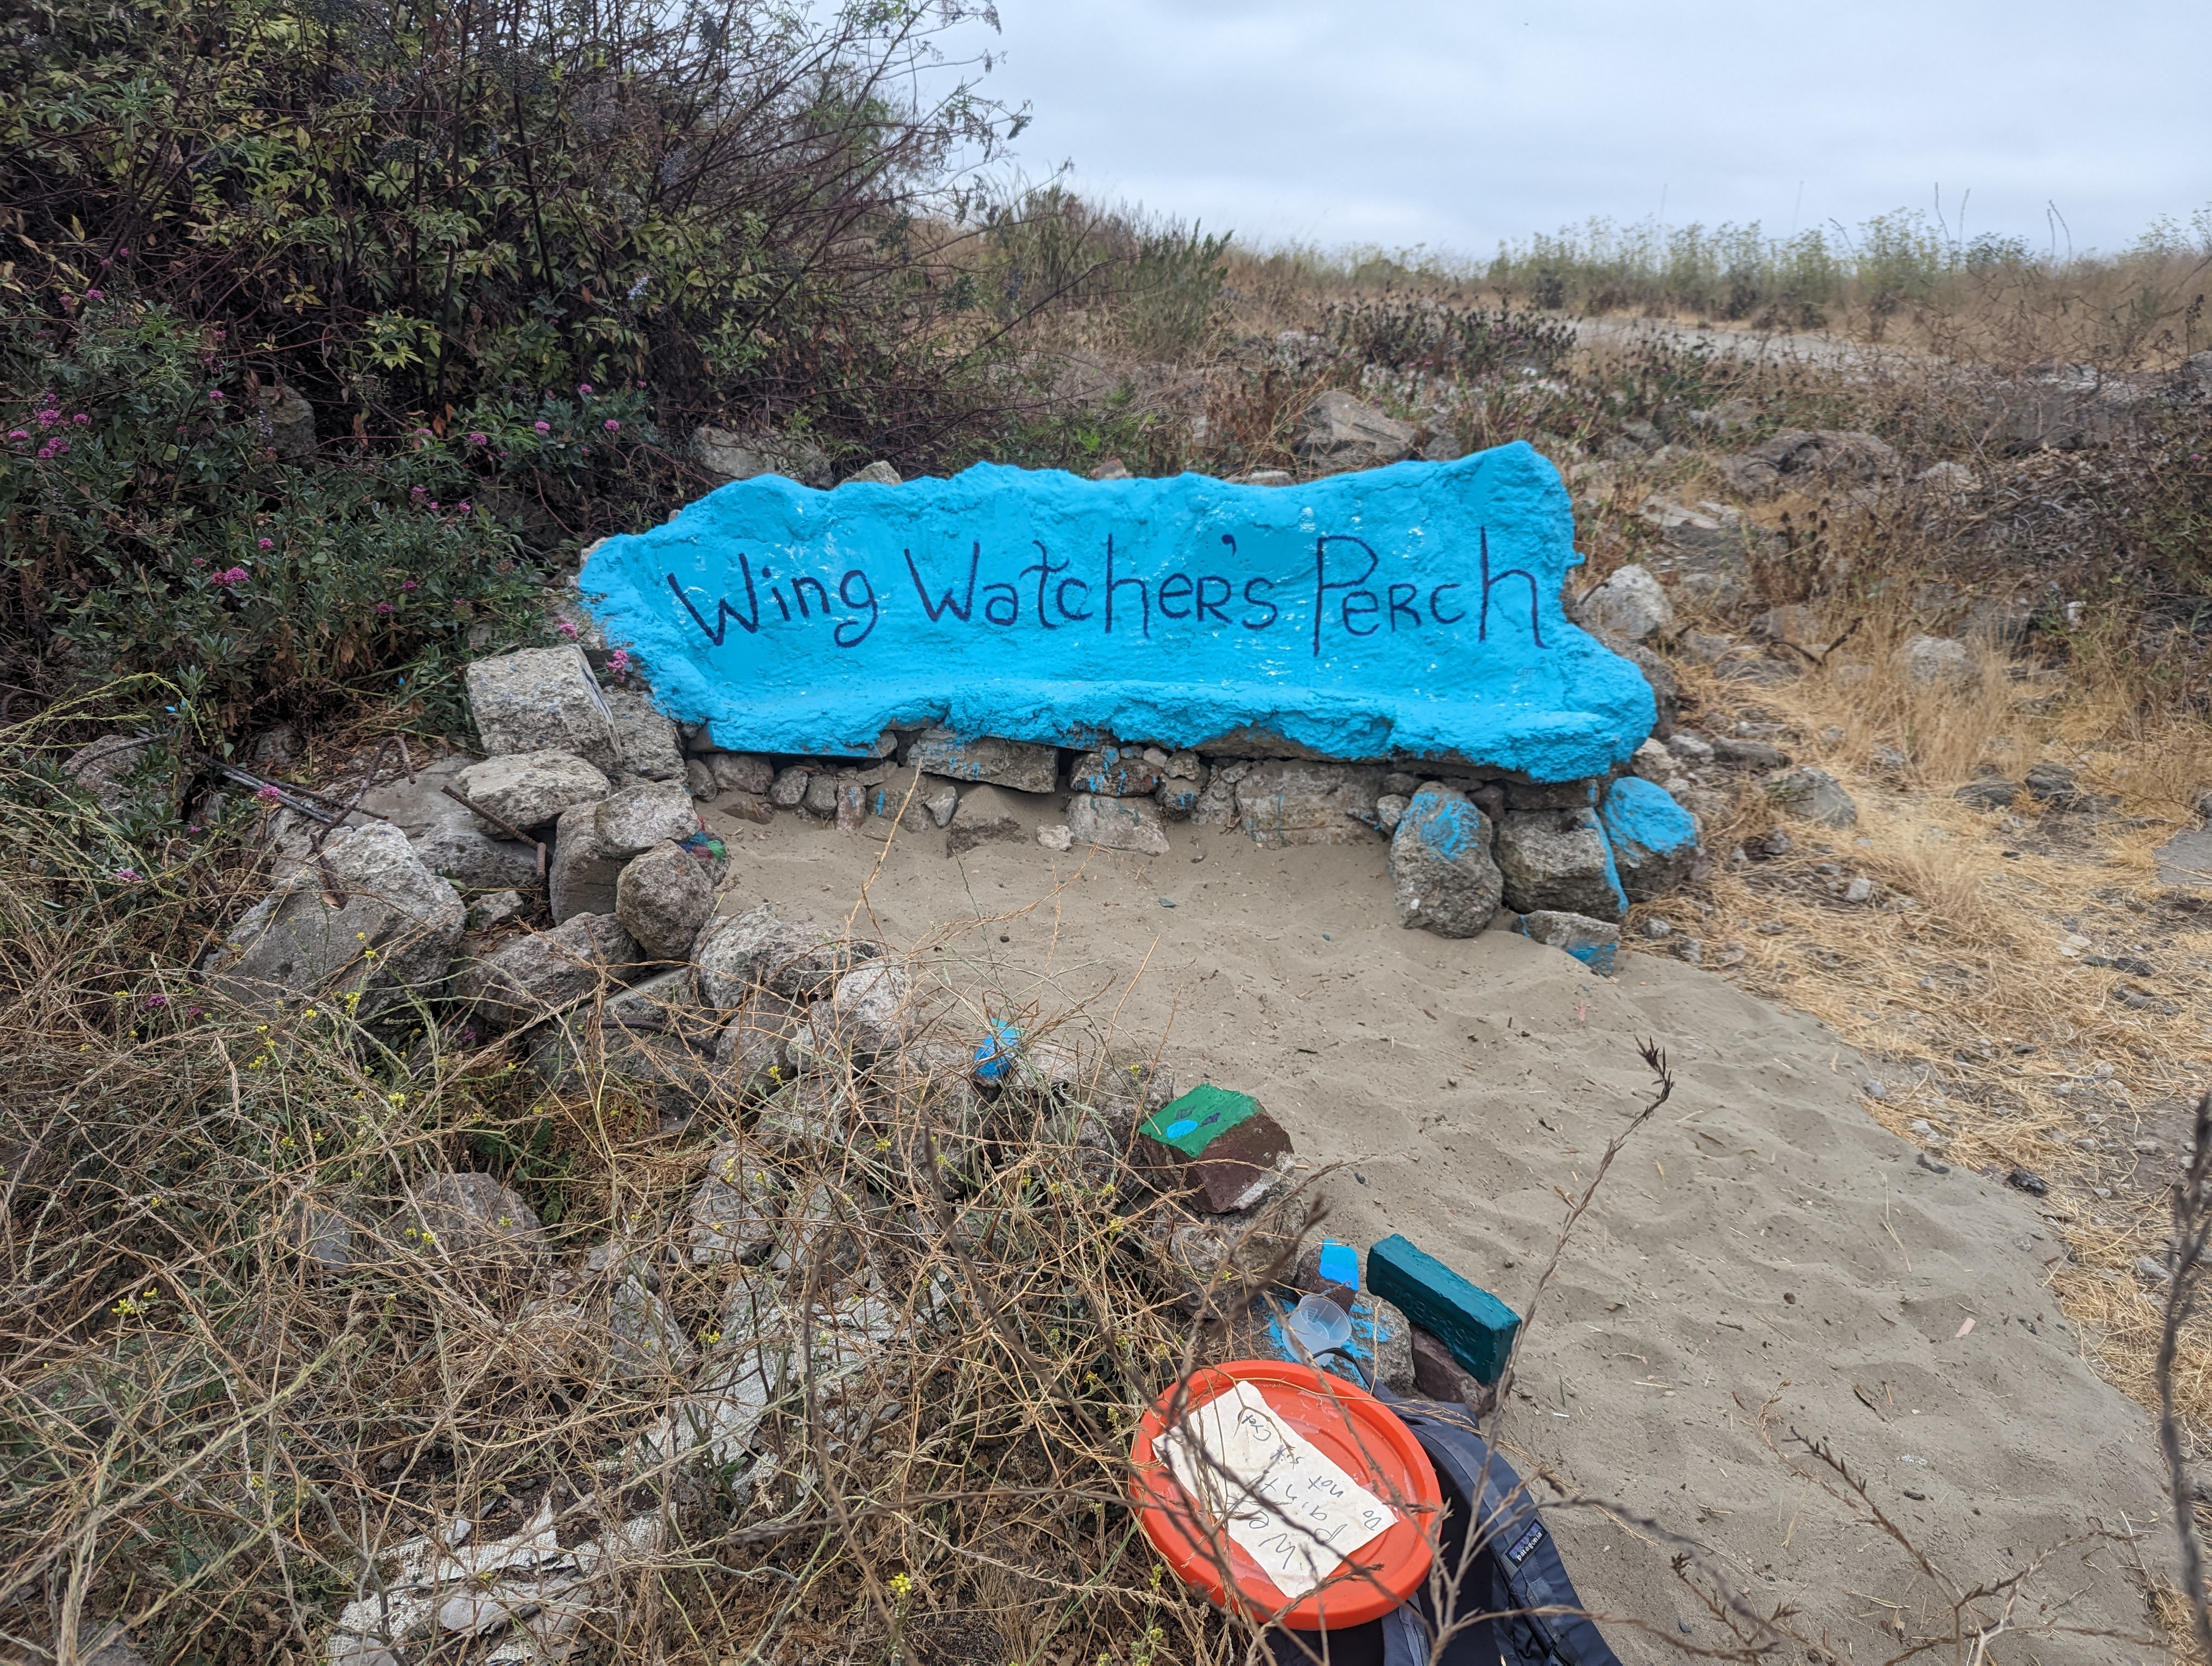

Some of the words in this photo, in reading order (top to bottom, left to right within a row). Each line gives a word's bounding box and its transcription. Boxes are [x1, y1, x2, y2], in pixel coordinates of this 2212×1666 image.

[667, 553, 878, 648] Wing
[1308, 1476, 1344, 1498] not
[1362, 1510, 1382, 1531] Do
[1516, 1531, 1542, 1562] patagonia
